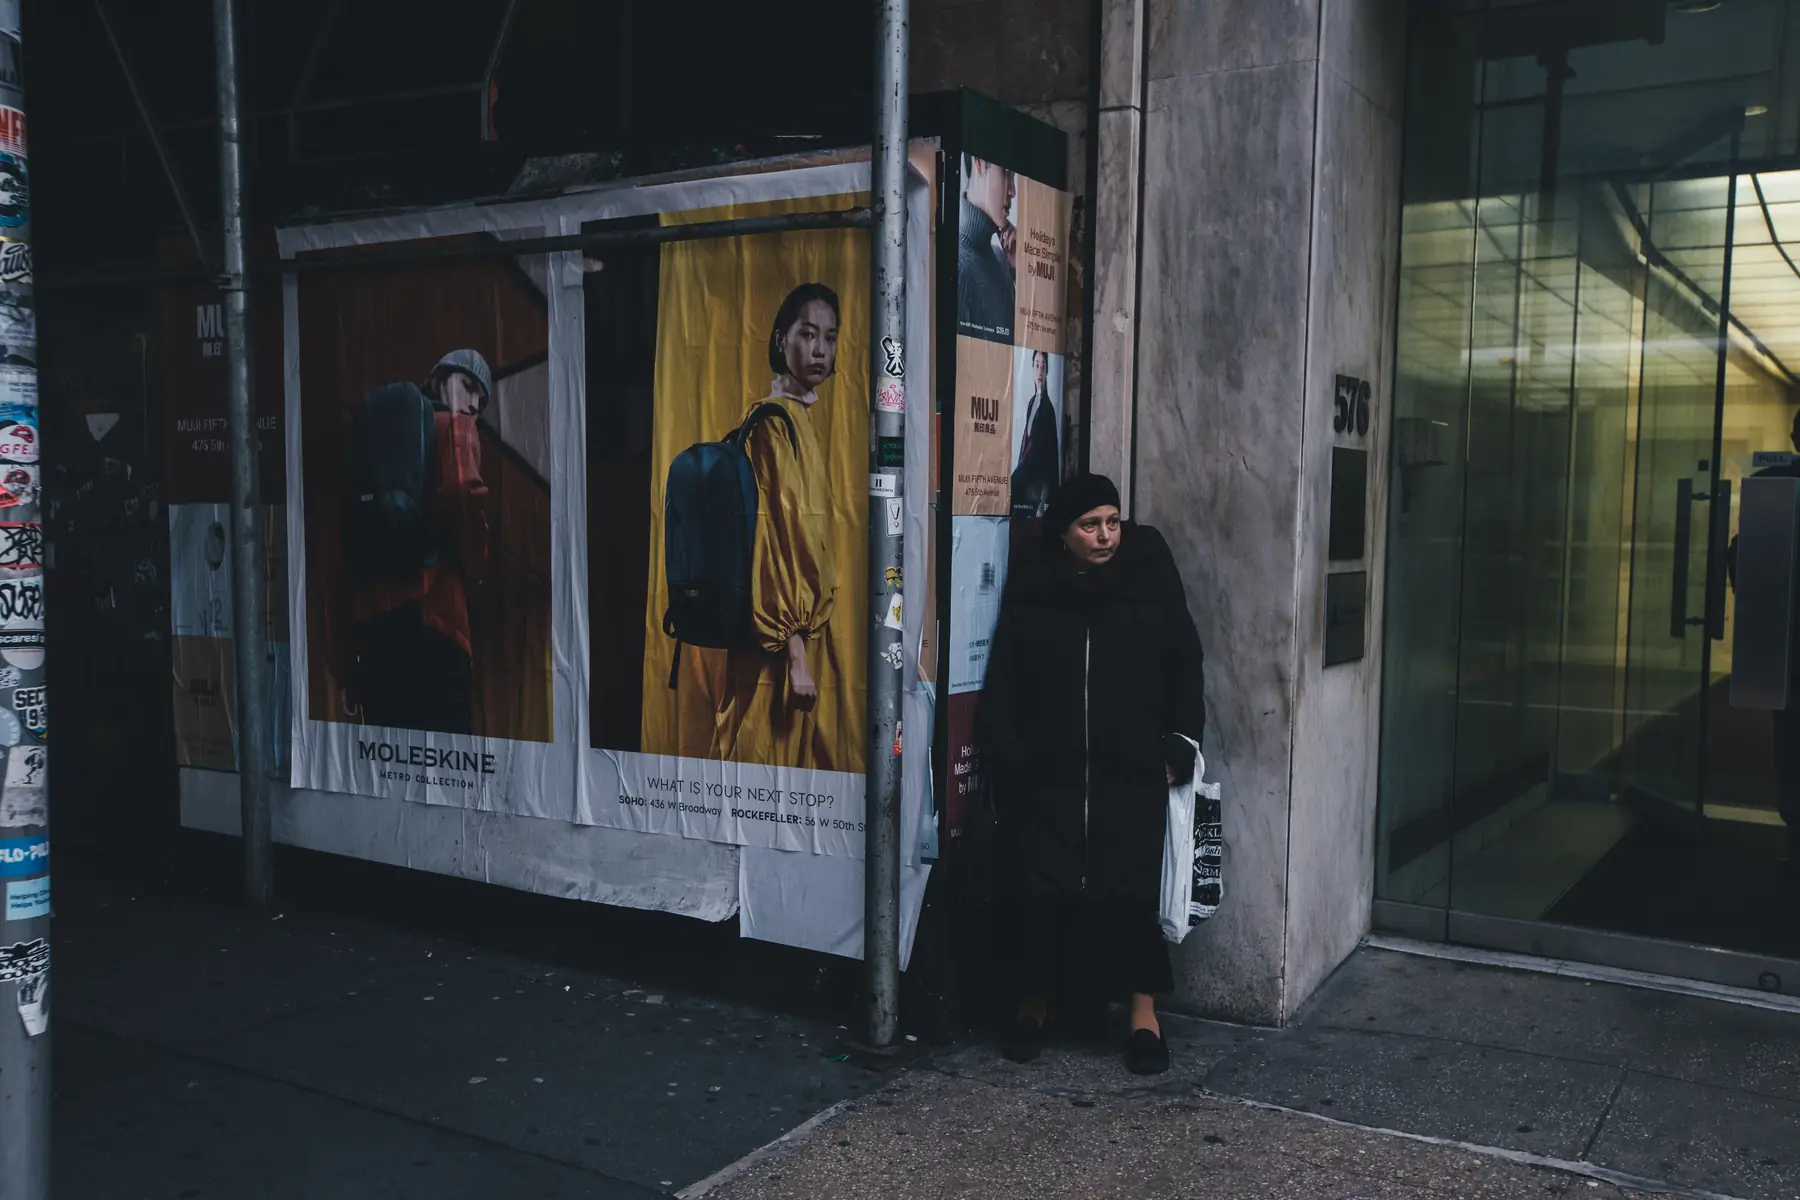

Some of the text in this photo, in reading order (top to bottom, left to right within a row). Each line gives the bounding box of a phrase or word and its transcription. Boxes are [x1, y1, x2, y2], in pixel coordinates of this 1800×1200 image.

[1037, 261, 1055, 281] MUJI
[196, 304, 225, 338] MU
[971, 396, 999, 422] MUJI
[1333, 374, 1371, 436] 576
[358, 740, 495, 775] MOLESKINE
[380, 771, 474, 789] METRO COLLECTION
[647, 777, 835, 809] WHAT IS YOUR NEXT STOP?
[619, 795, 647, 807] SOHO:
[650, 799, 665, 809] 436
[667, 801, 676, 810] W
[679, 802, 722, 817] Broadway
[731, 808, 802, 825] ROCKEFELLER:
[804, 816, 816, 827] 56
[819, 818, 830, 828] W
[833, 819, 855, 832] 50th
